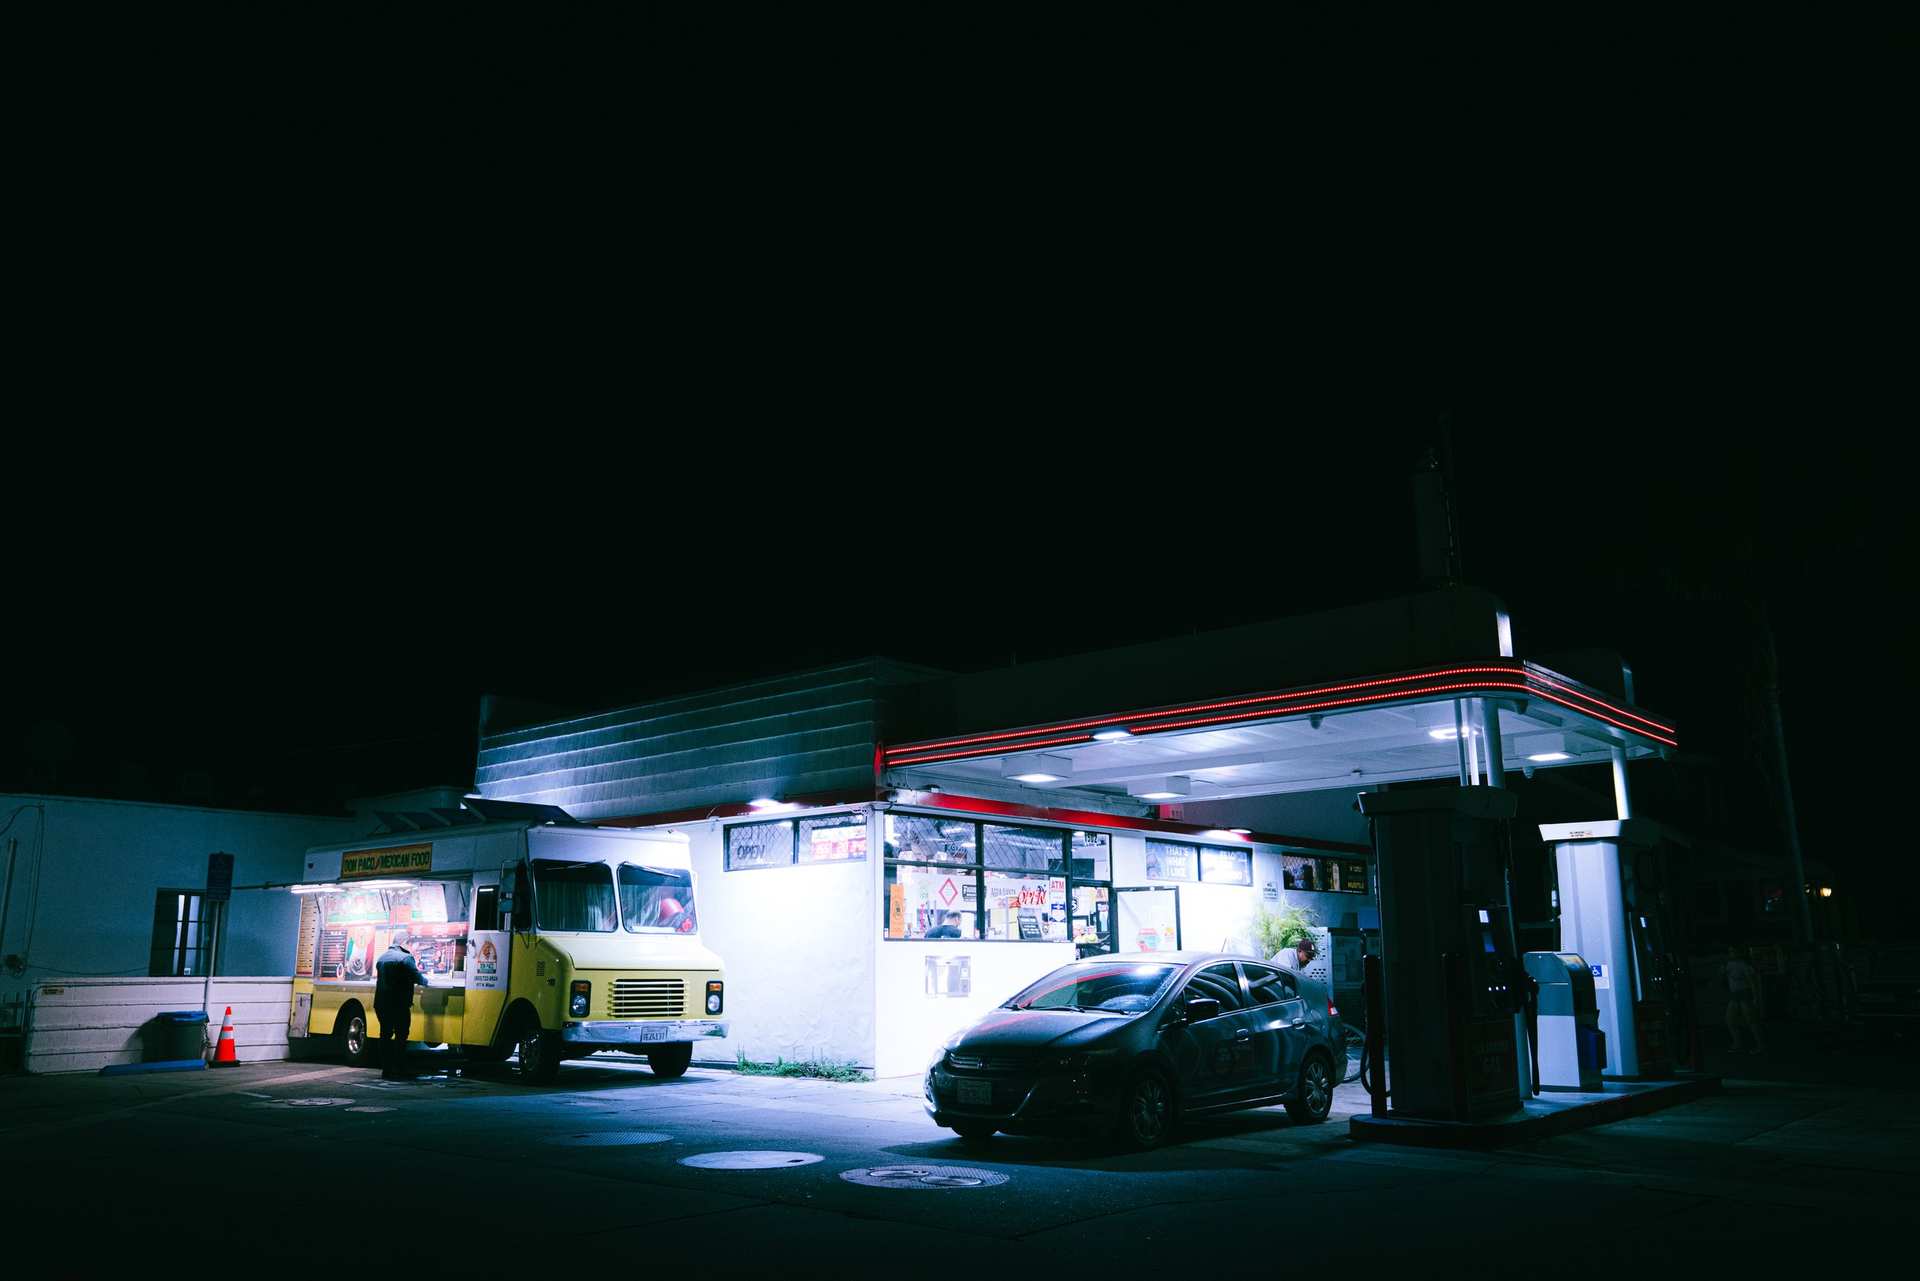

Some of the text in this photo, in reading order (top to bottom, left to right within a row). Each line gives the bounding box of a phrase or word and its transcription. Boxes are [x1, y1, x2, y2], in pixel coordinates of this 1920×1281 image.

[379, 852, 410, 868] MEXICAN
[411, 851, 430, 866] FOOD
[737, 844, 765, 860] OPEN
[1050, 880, 1064, 889] ATM
[1018, 890, 1047, 905] OPEN
